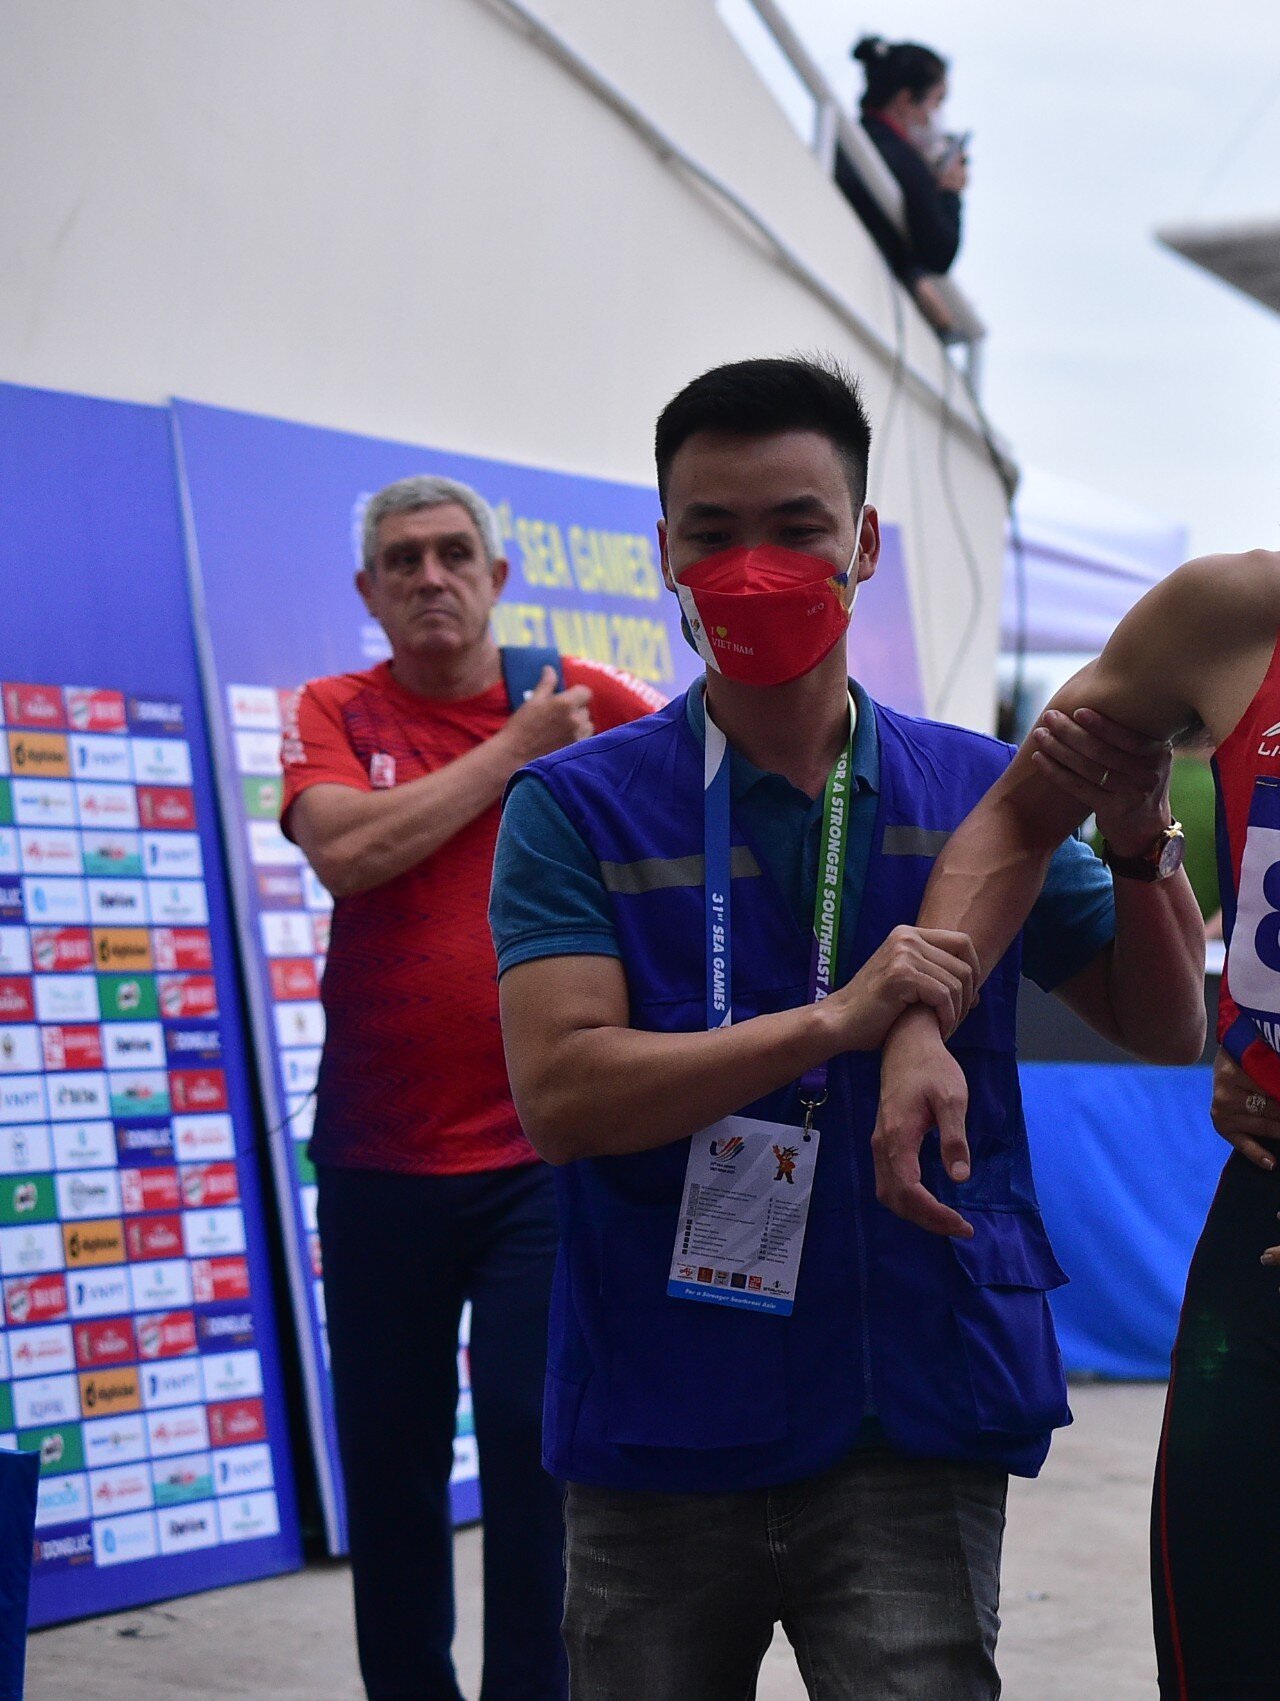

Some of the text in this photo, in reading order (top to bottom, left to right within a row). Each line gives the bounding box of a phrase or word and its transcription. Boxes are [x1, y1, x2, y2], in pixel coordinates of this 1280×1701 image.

[711, 637, 755, 656] VIET NAM
[834, 751, 849, 779] FOR
[832, 781, 844, 793] A
[825, 796, 845, 886] STRONGER
[712, 925, 725, 953] SEA
[816, 887, 835, 986] SOUTHEAST
[713, 957, 726, 1011] GAMES
[702, 1291, 730, 1301] Stronger
[731, 1296, 761, 1306] Southeast
